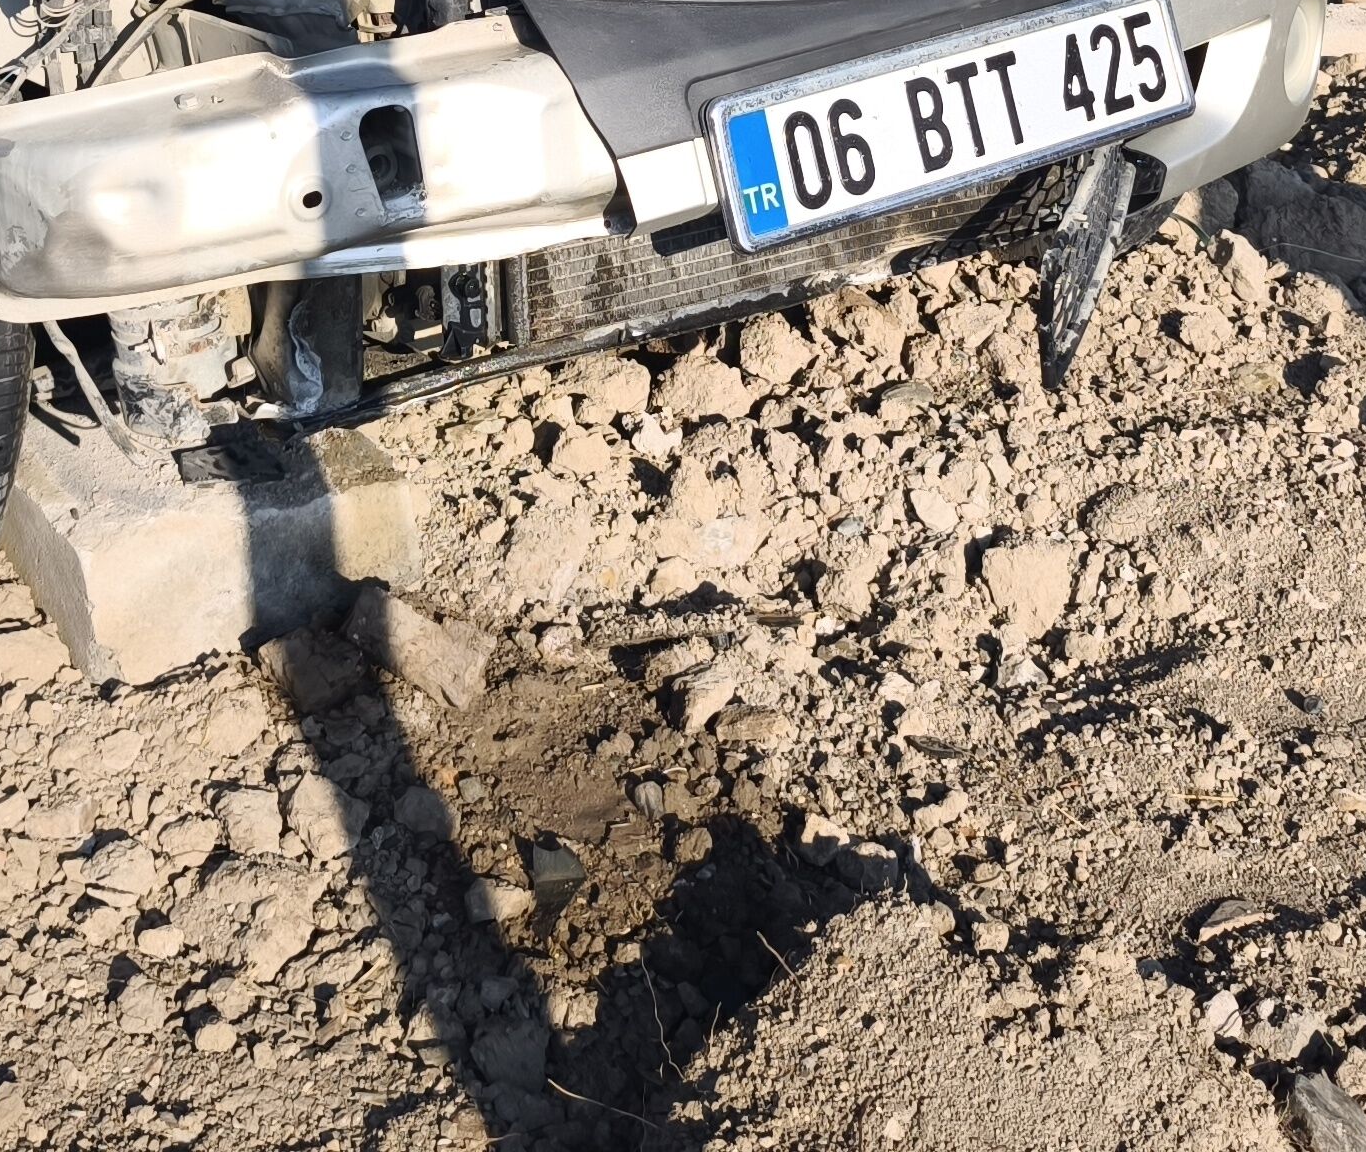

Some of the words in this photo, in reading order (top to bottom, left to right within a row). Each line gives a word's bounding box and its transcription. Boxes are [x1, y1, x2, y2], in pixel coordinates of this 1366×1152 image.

[743, 182, 779, 215] TR
[783, 98, 875, 209] 06
[905, 51, 1025, 173] BTT
[1064, 12, 1166, 121] 425
